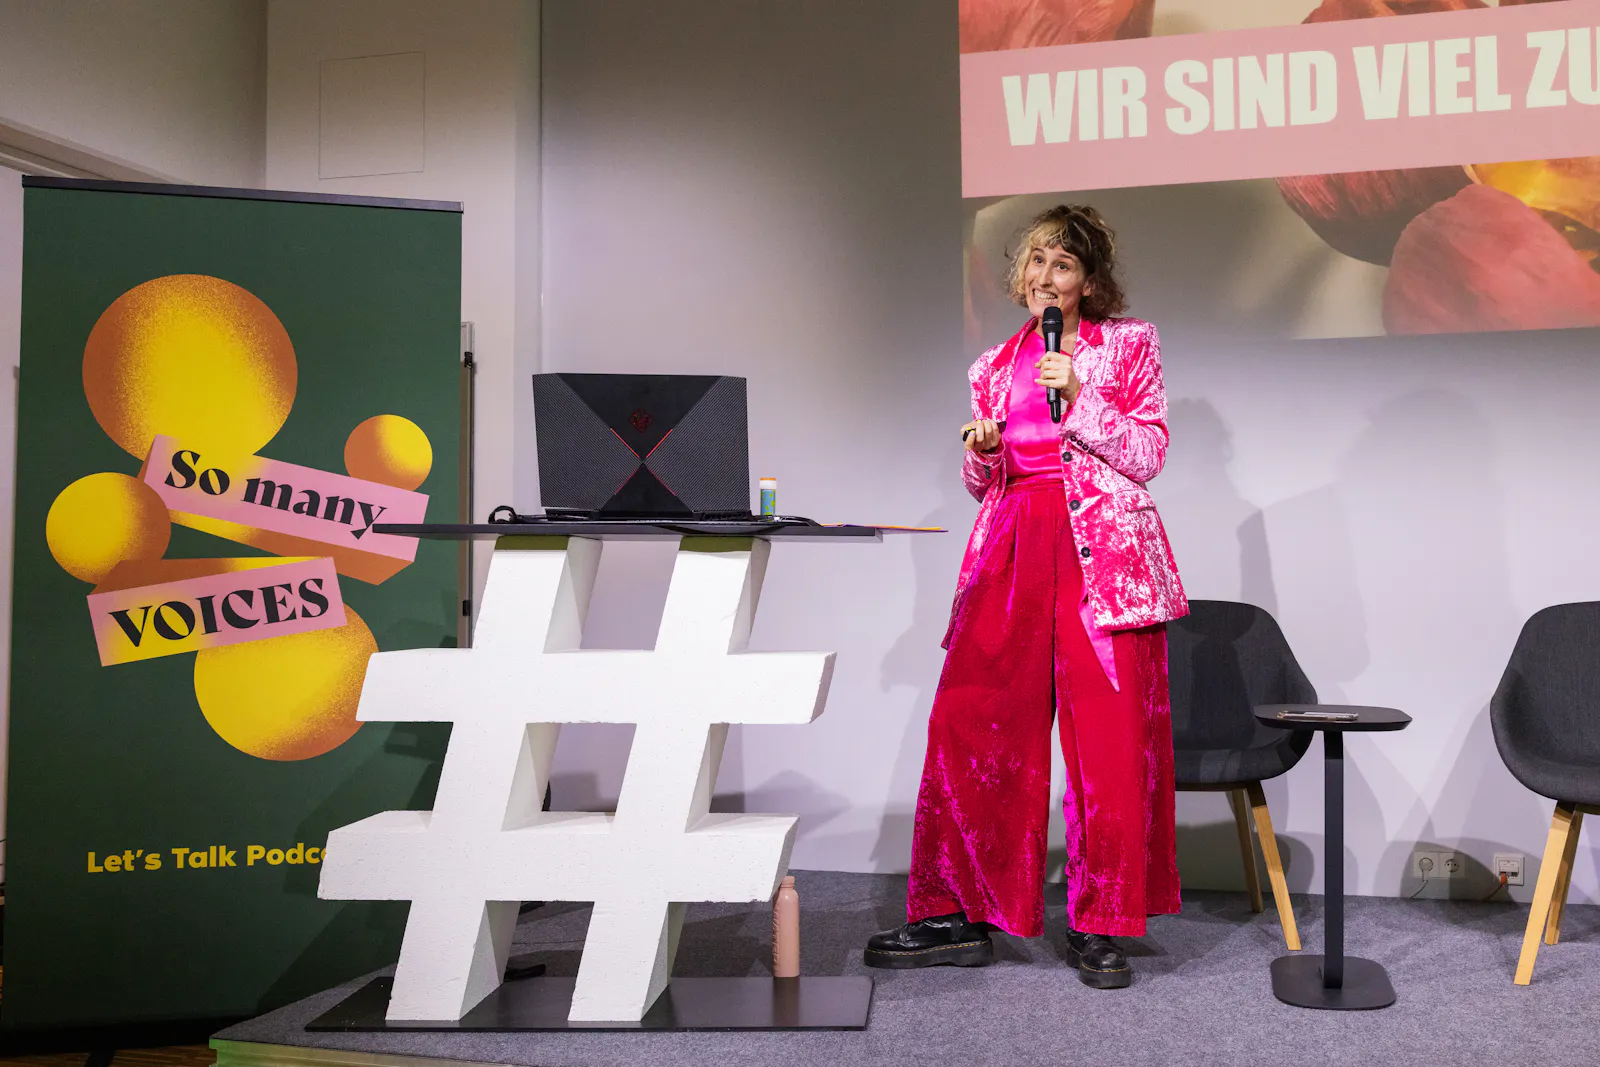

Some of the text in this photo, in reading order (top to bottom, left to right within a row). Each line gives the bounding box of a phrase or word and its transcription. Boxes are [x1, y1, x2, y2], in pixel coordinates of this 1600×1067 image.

[1002, 26, 1600, 147] WIR SIND VIEL ZU
[164, 449, 388, 541] So many
[108, 577, 330, 649] VOICES
[87, 848, 163, 873] Let’s
[171, 844, 238, 869] Talk
